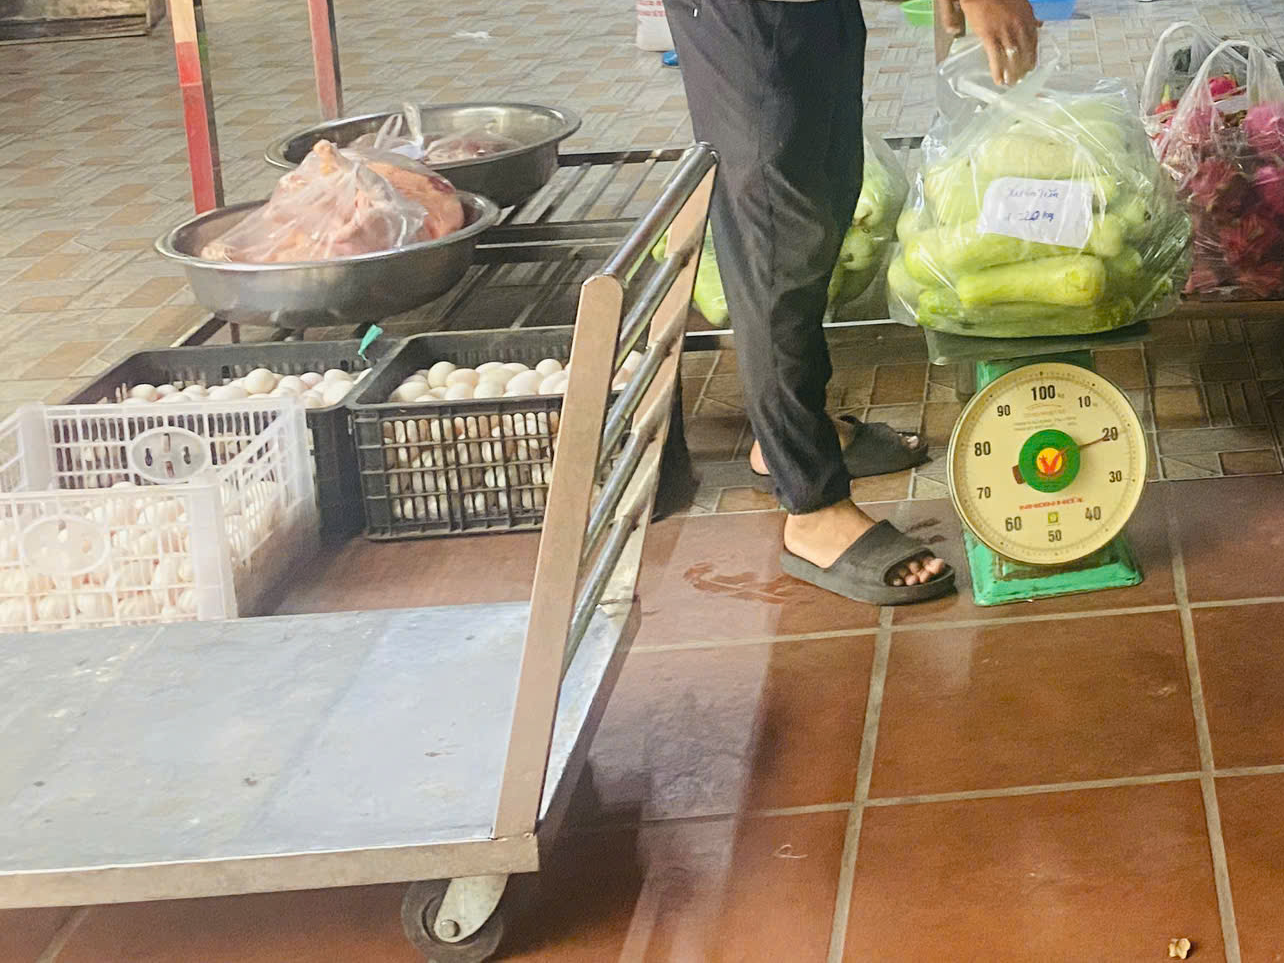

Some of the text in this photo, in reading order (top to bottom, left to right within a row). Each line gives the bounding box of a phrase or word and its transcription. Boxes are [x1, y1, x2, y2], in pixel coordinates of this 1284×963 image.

[1031, 384, 1056, 401] 100
[1078, 395, 1091, 408] 10
[997, 404, 1011, 417] 90
[1102, 426, 1118, 442] 20
[974, 441, 991, 457] 80
[1109, 470, 1122, 483] 30
[977, 486, 991, 499] 70
[1085, 506, 1101, 521] 40
[1005, 516, 1022, 532] 60
[1048, 529, 1062, 542] 50
